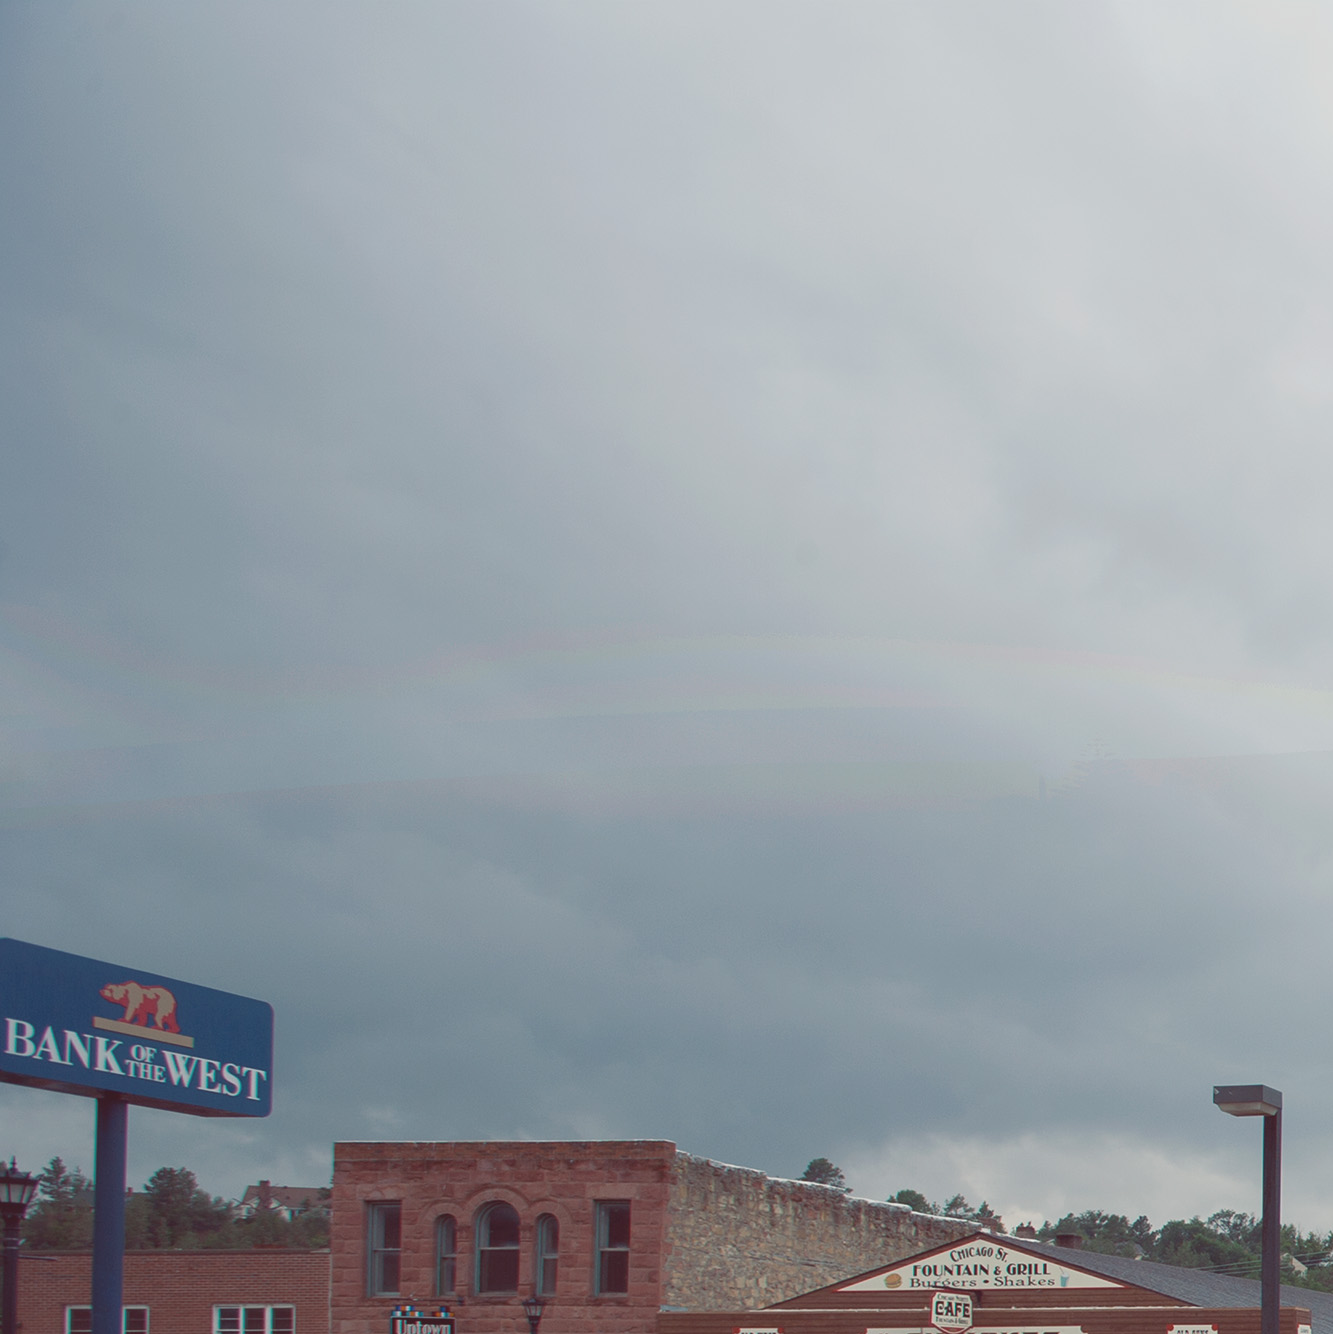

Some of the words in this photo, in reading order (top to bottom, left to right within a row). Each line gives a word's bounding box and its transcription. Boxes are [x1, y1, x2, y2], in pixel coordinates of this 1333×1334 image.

[5, 1017, 126, 1076] BANK
[130, 1044, 158, 1064] OF
[125, 1059, 167, 1083] THE
[162, 1050, 268, 1101] WEST
[950, 1246, 994, 1263] CHICAGO
[912, 1264, 990, 1277] FOUNTAIN
[993, 1265, 1002, 1276] &
[1006, 1263, 1051, 1276] GRILL
[910, 1277, 977, 1289] Burgers
[993, 1276, 1055, 1287] Shakes
[935, 1300, 970, 1318] CAFE
